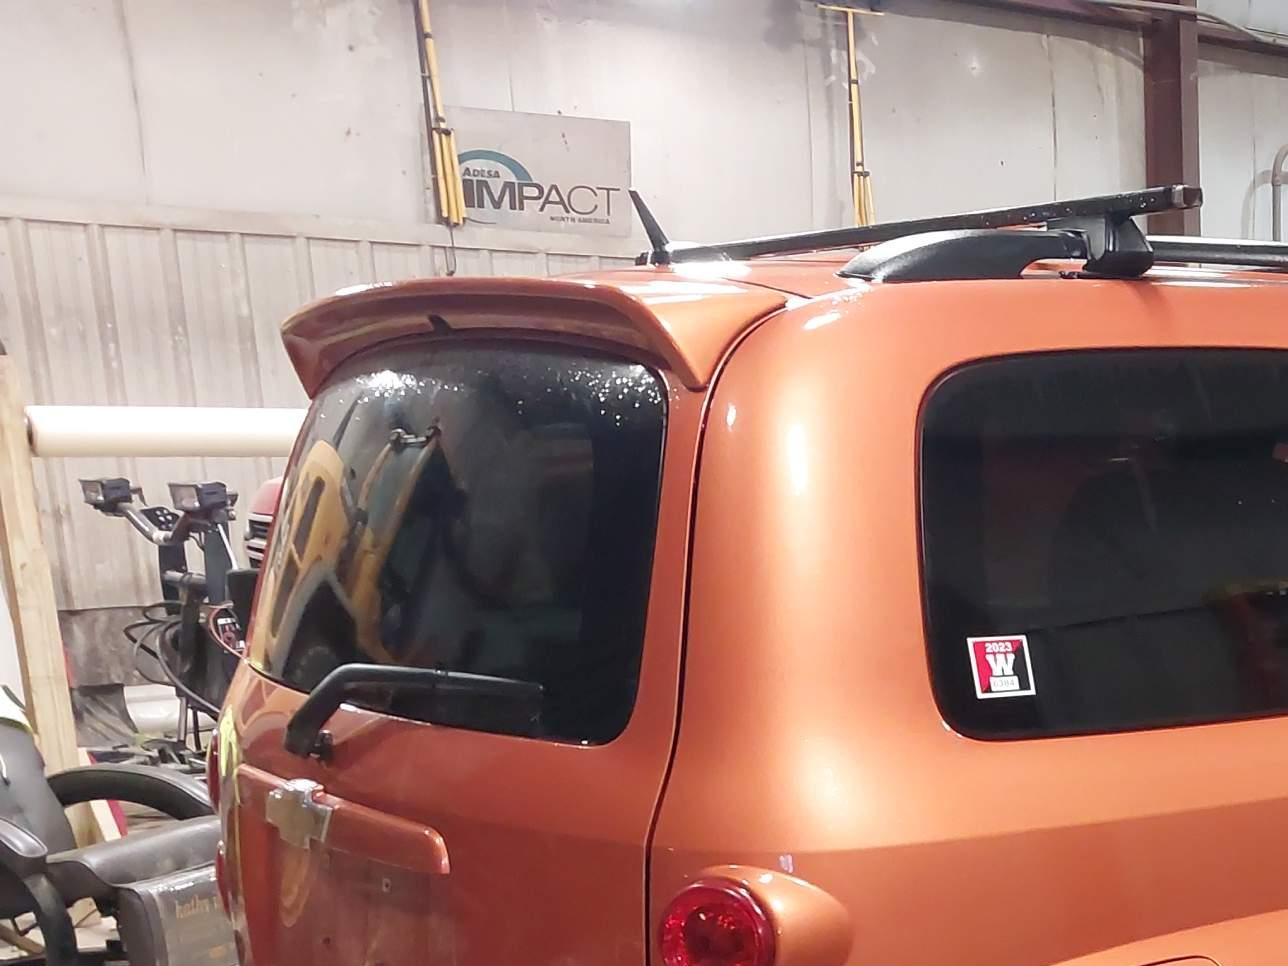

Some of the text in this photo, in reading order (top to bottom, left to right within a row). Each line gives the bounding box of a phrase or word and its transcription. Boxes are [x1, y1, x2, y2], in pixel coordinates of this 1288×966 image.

[462, 167, 500, 178] ADESA
[462, 179, 621, 216] IMPACT
[985, 641, 1013, 653] 2023
[985, 652, 1015, 676] W
